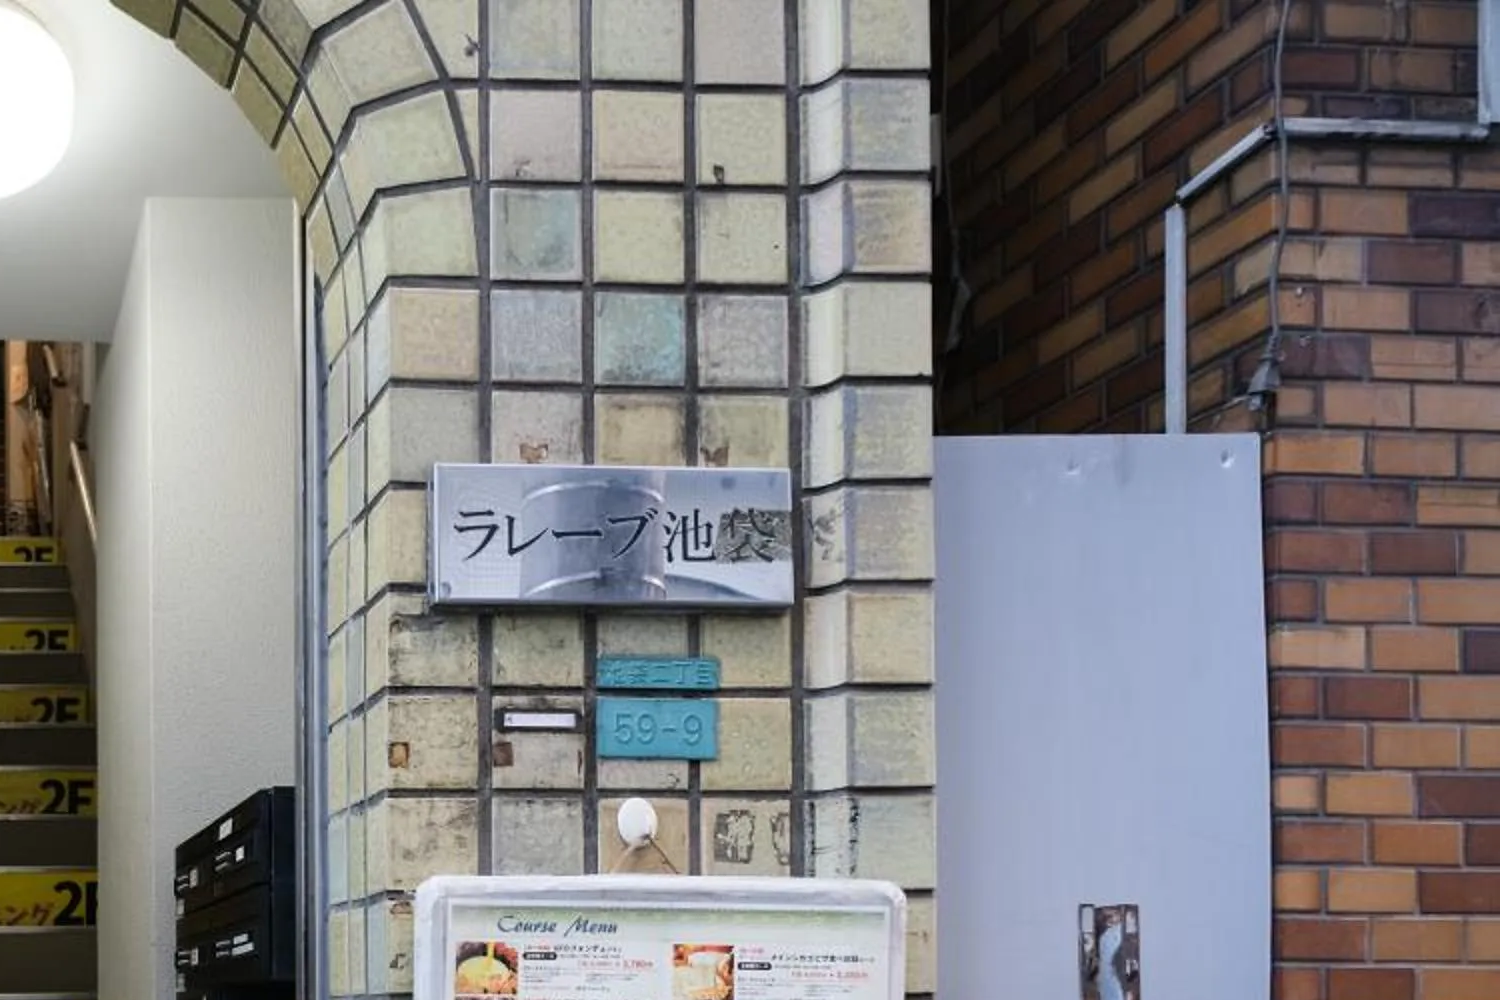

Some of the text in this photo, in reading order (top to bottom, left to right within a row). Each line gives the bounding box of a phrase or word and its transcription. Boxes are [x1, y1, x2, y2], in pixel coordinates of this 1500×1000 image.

[453, 507, 778, 563] ラレーブ池袋
[614, 710, 703, 747] 59-9
[39, 778, 95, 815] 2F
[497, 914, 619, 938] Course Menu
